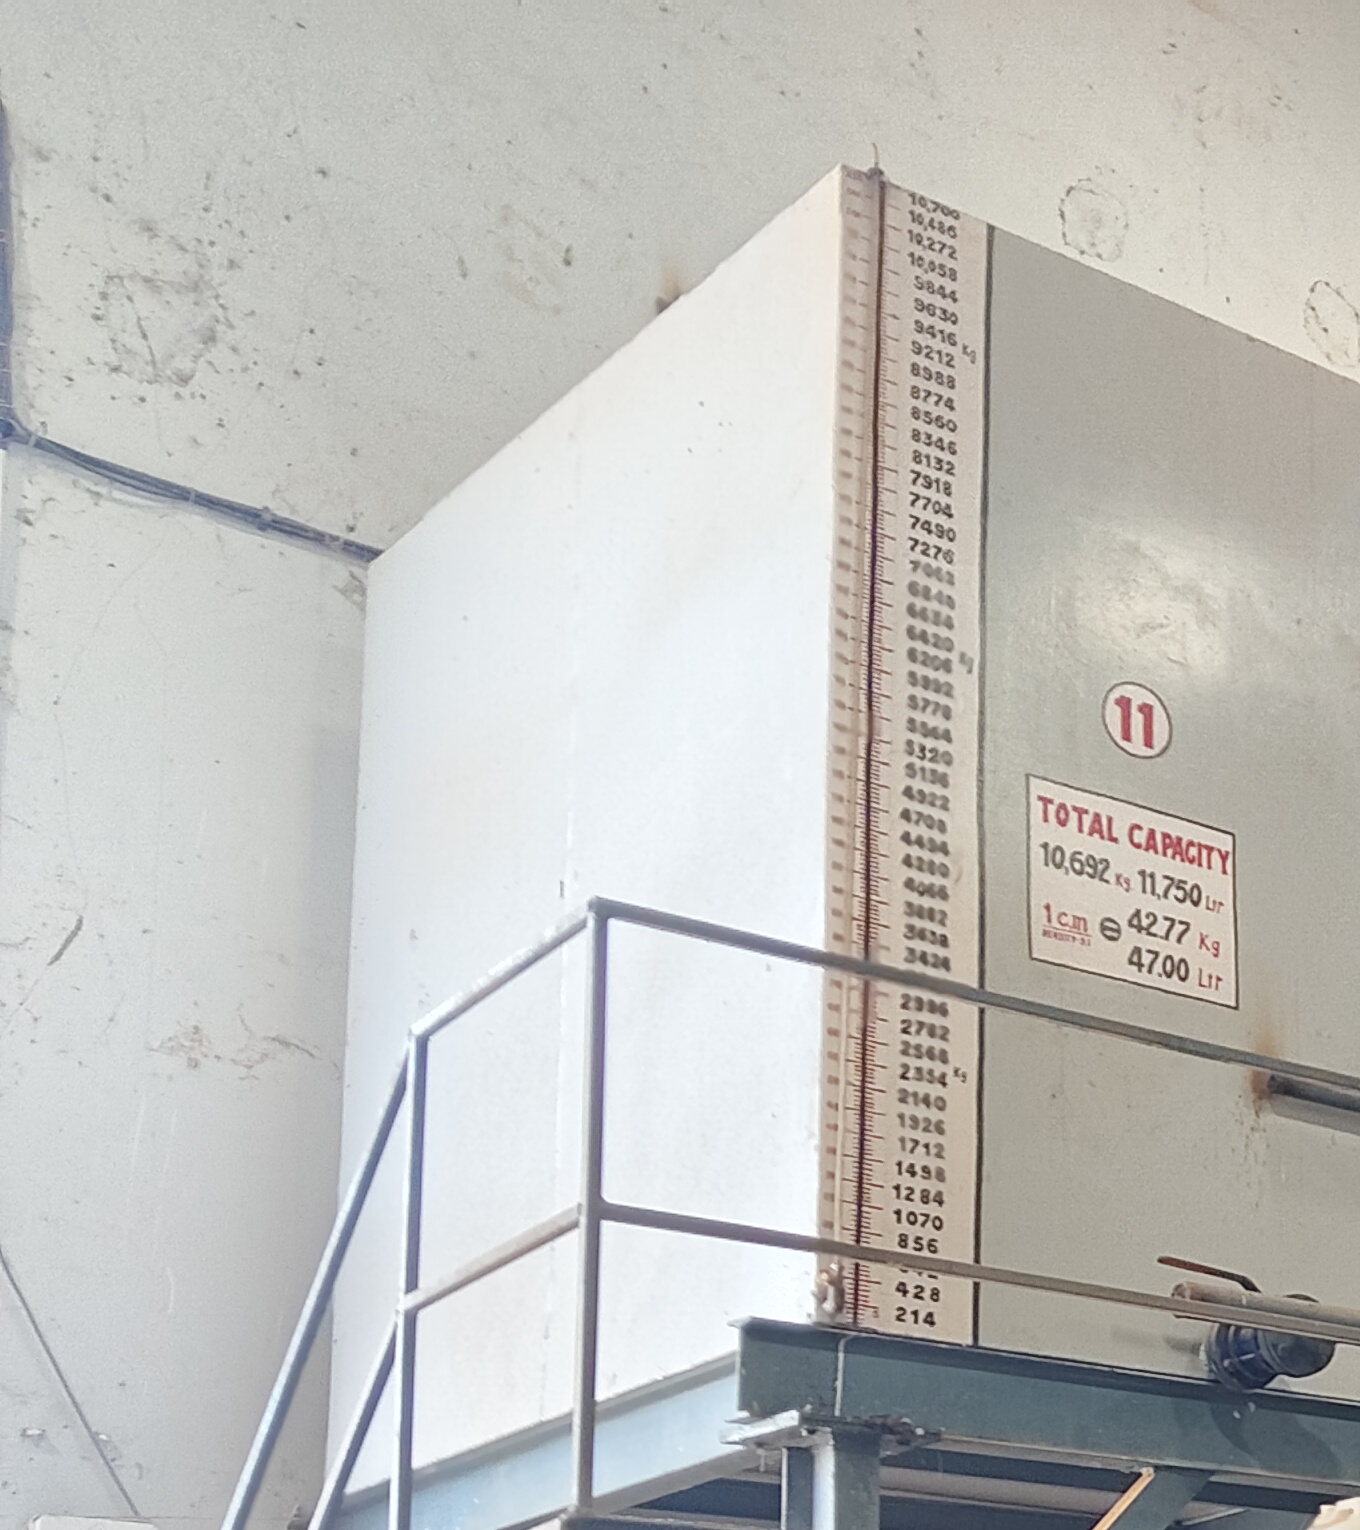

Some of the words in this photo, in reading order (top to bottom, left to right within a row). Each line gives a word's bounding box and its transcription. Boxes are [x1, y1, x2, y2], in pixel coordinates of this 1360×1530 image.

[907, 229, 958, 261] 10,272
[913, 275, 959, 303] 9844
[913, 297, 959, 325] 9630
[914, 319, 957, 347] 9416
[911, 340, 956, 368] 9212
[910, 362, 957, 389] 8988
[910, 384, 956, 412] 8774
[911, 406, 958, 433] 8560
[911, 427, 957, 456] 8346
[912, 449, 956, 477] 8132
[909, 470, 953, 497] 7918
[908, 491, 954, 519] 7704
[908, 514, 957, 543] 7490
[907, 536, 954, 565] 7276
[1114, 695, 1155, 751] 11
[1037, 794, 1119, 845] TOTAL
[1127, 823, 1230, 876] CAPACITY
[1039, 841, 1111, 884] 10,692
[1137, 868, 1202, 908] 11,750
[1199, 932, 1220, 958] Kg
[1127, 945, 1190, 982] 47.00
[897, 1087, 946, 1113] 2140
[898, 1112, 946, 1137] 1926
[898, 1136, 946, 1160] 1712
[895, 1161, 946, 1184] 1498
[892, 1183, 945, 1208] 1284
[893, 1208, 944, 1232] 1070
[897, 1233, 938, 1255] 856
[895, 1279, 941, 1303] 428
[895, 1307, 936, 1328] 214
